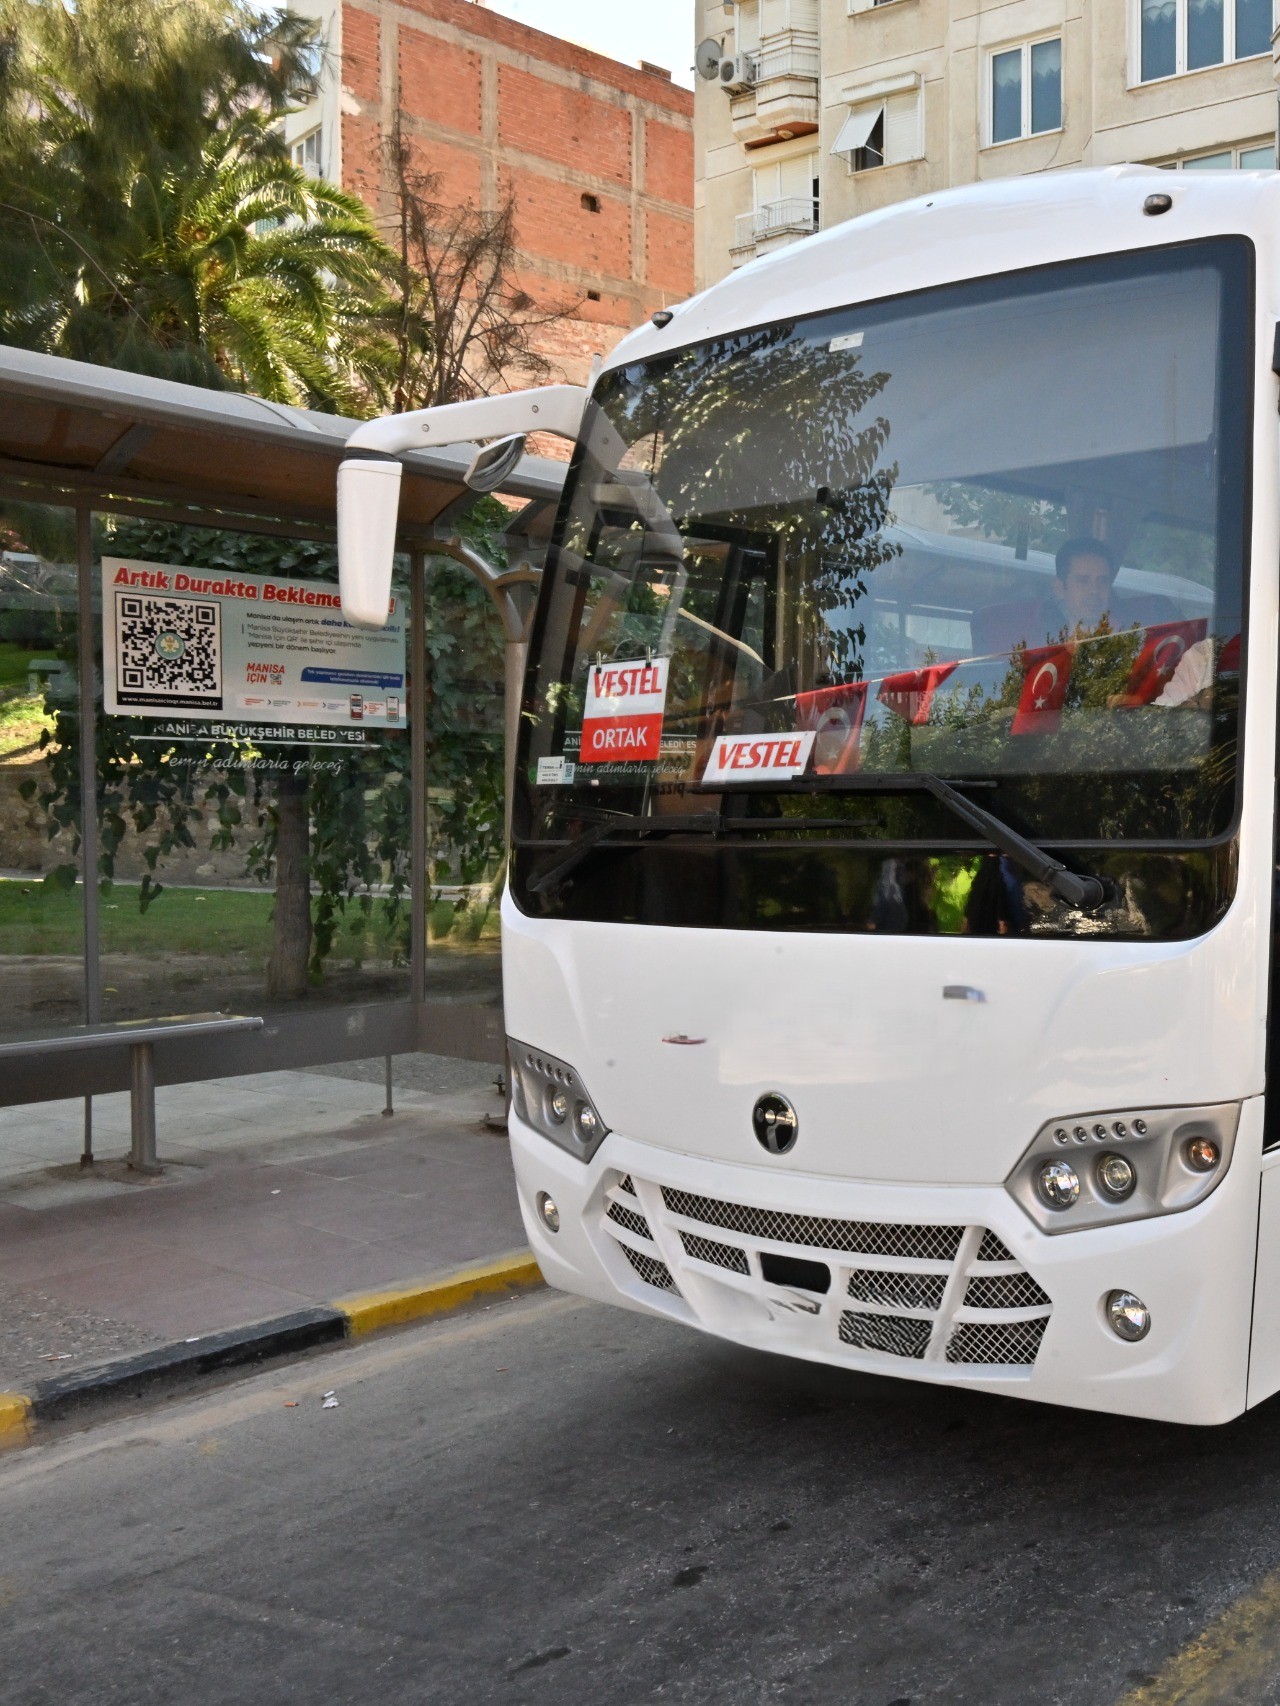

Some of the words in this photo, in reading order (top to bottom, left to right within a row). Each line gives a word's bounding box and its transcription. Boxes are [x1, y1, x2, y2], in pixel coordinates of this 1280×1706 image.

[113, 567, 170, 590] Artık
[174, 573, 258, 599] Durakta
[321, 618, 343, 627] daha
[594, 667, 662, 698] VESTEL
[592, 726, 648, 749] ORTAK
[717, 740, 802, 770] VESTEL
